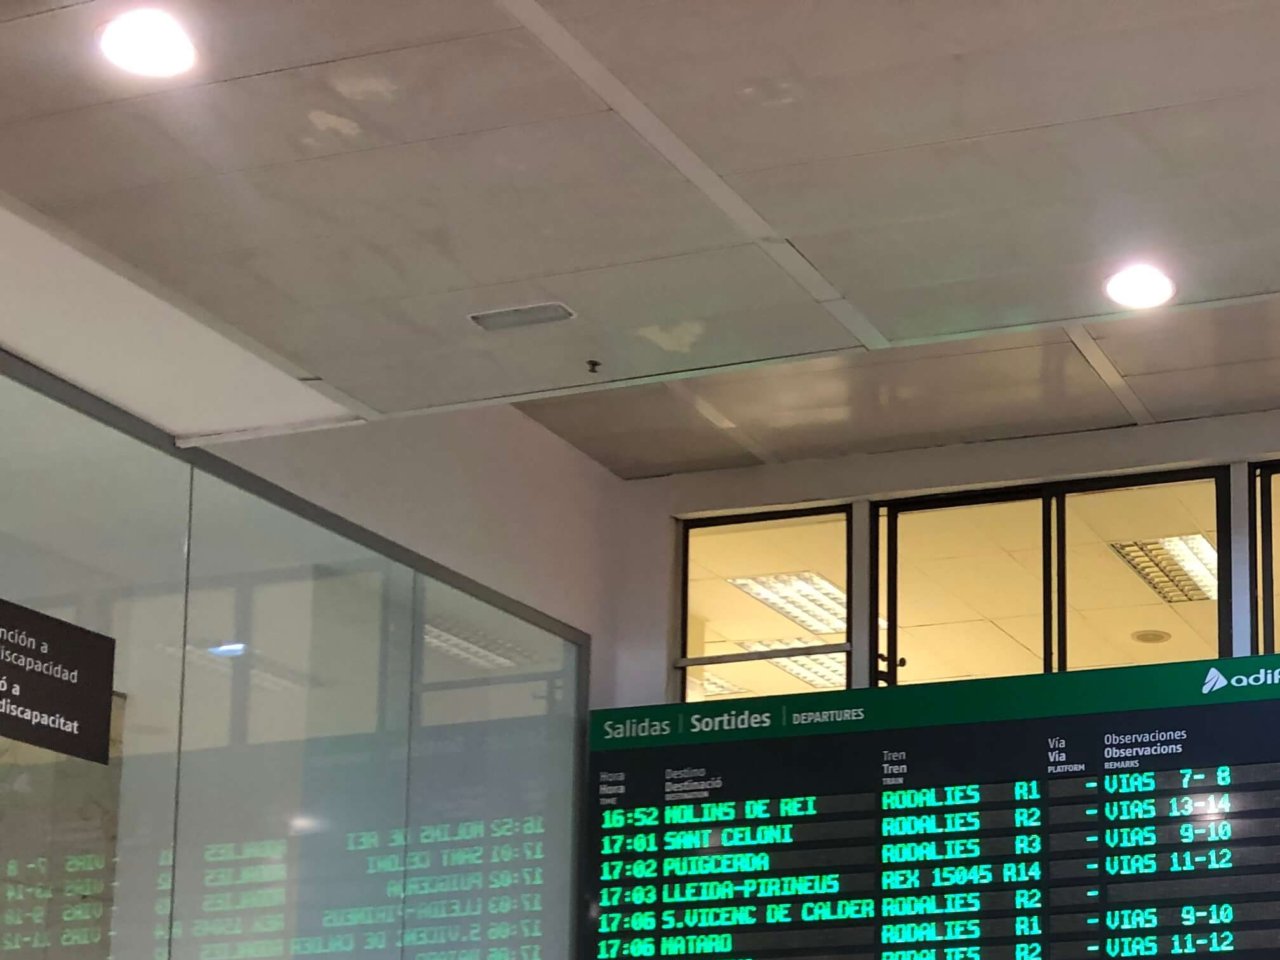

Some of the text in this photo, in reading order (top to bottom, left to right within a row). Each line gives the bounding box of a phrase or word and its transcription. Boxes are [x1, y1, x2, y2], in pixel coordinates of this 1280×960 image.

[40, 641, 49, 654] a
[11, 683, 20, 696] a
[603, 708, 865, 739] Salidas Sortides DEPARTURES
[1048, 737, 1066, 749] Vía
[1104, 729, 1187, 746] Observaciones
[882, 750, 906, 761] Tren
[1104, 742, 1183, 759] Observacions
[882, 763, 908, 774] Tren
[1047, 763, 1085, 774] PLATFORM
[1104, 759, 1140, 770] REMARKS
[665, 777, 723, 793] Destinació
[601, 771, 1156, 829] 16:52 MOLINS DE REI RODALIES R1 VIAS
[601, 793, 1231, 854] 17:01 SANT CELONI RODALIES R2 VIAS 13-14
[600, 853, 770, 881] 17:02 PUIGCERDA
[599, 886, 657, 907] 17:03
[662, 874, 840, 903] LLEIDA-PIRINEUS
[881, 869, 920, 890] REX
[1003, 862, 1042, 883] R14
[1105, 853, 1157, 876] VIAS
[1169, 848, 1233, 872] 11-12
[661, 906, 757, 930] S.VICENC
[766, 904, 792, 923] DE
[802, 899, 875, 921] CALDER
[661, 934, 733, 956] MATARO
